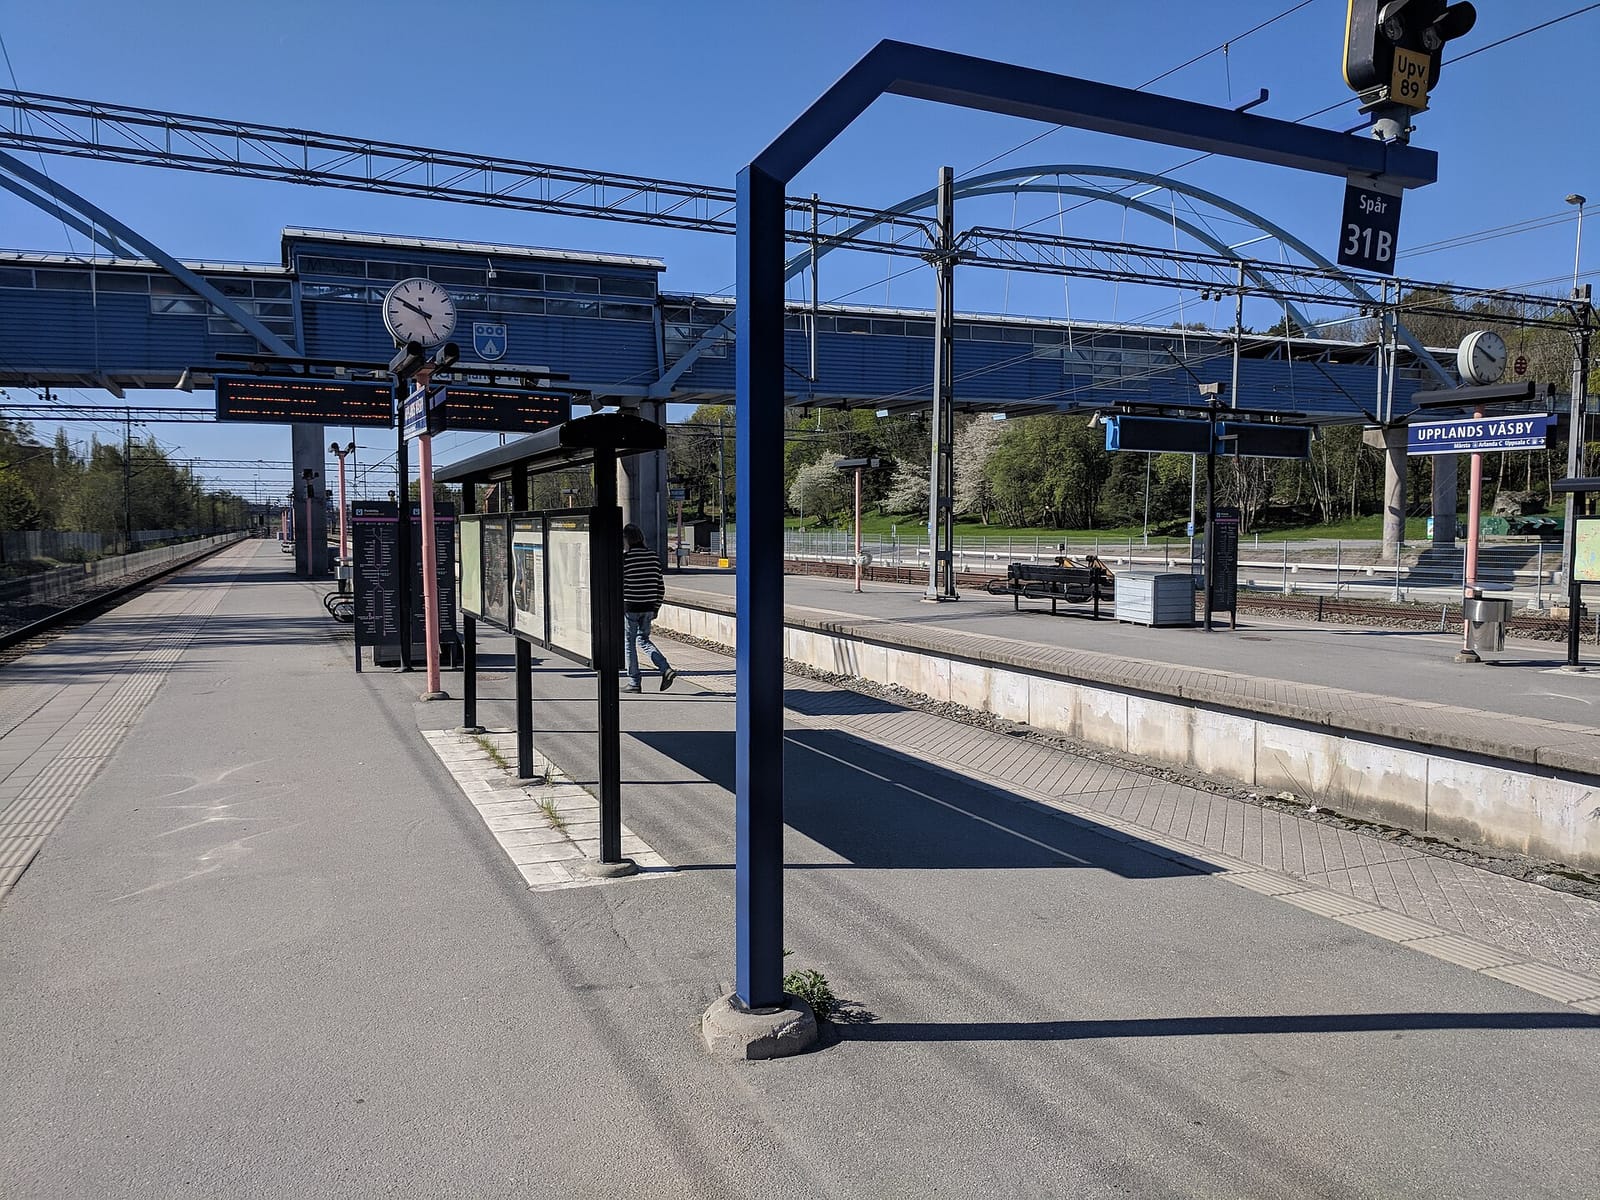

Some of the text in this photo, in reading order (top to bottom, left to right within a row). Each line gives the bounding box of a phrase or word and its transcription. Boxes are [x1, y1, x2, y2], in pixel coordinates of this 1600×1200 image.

[1397, 55, 1426, 79] Upv
[1400, 79, 1420, 99] 89
[1359, 194, 1388, 215] Spår
[1344, 223, 1393, 263] 31B
[1418, 421, 1534, 441] UPPLANDS VÄSBY
